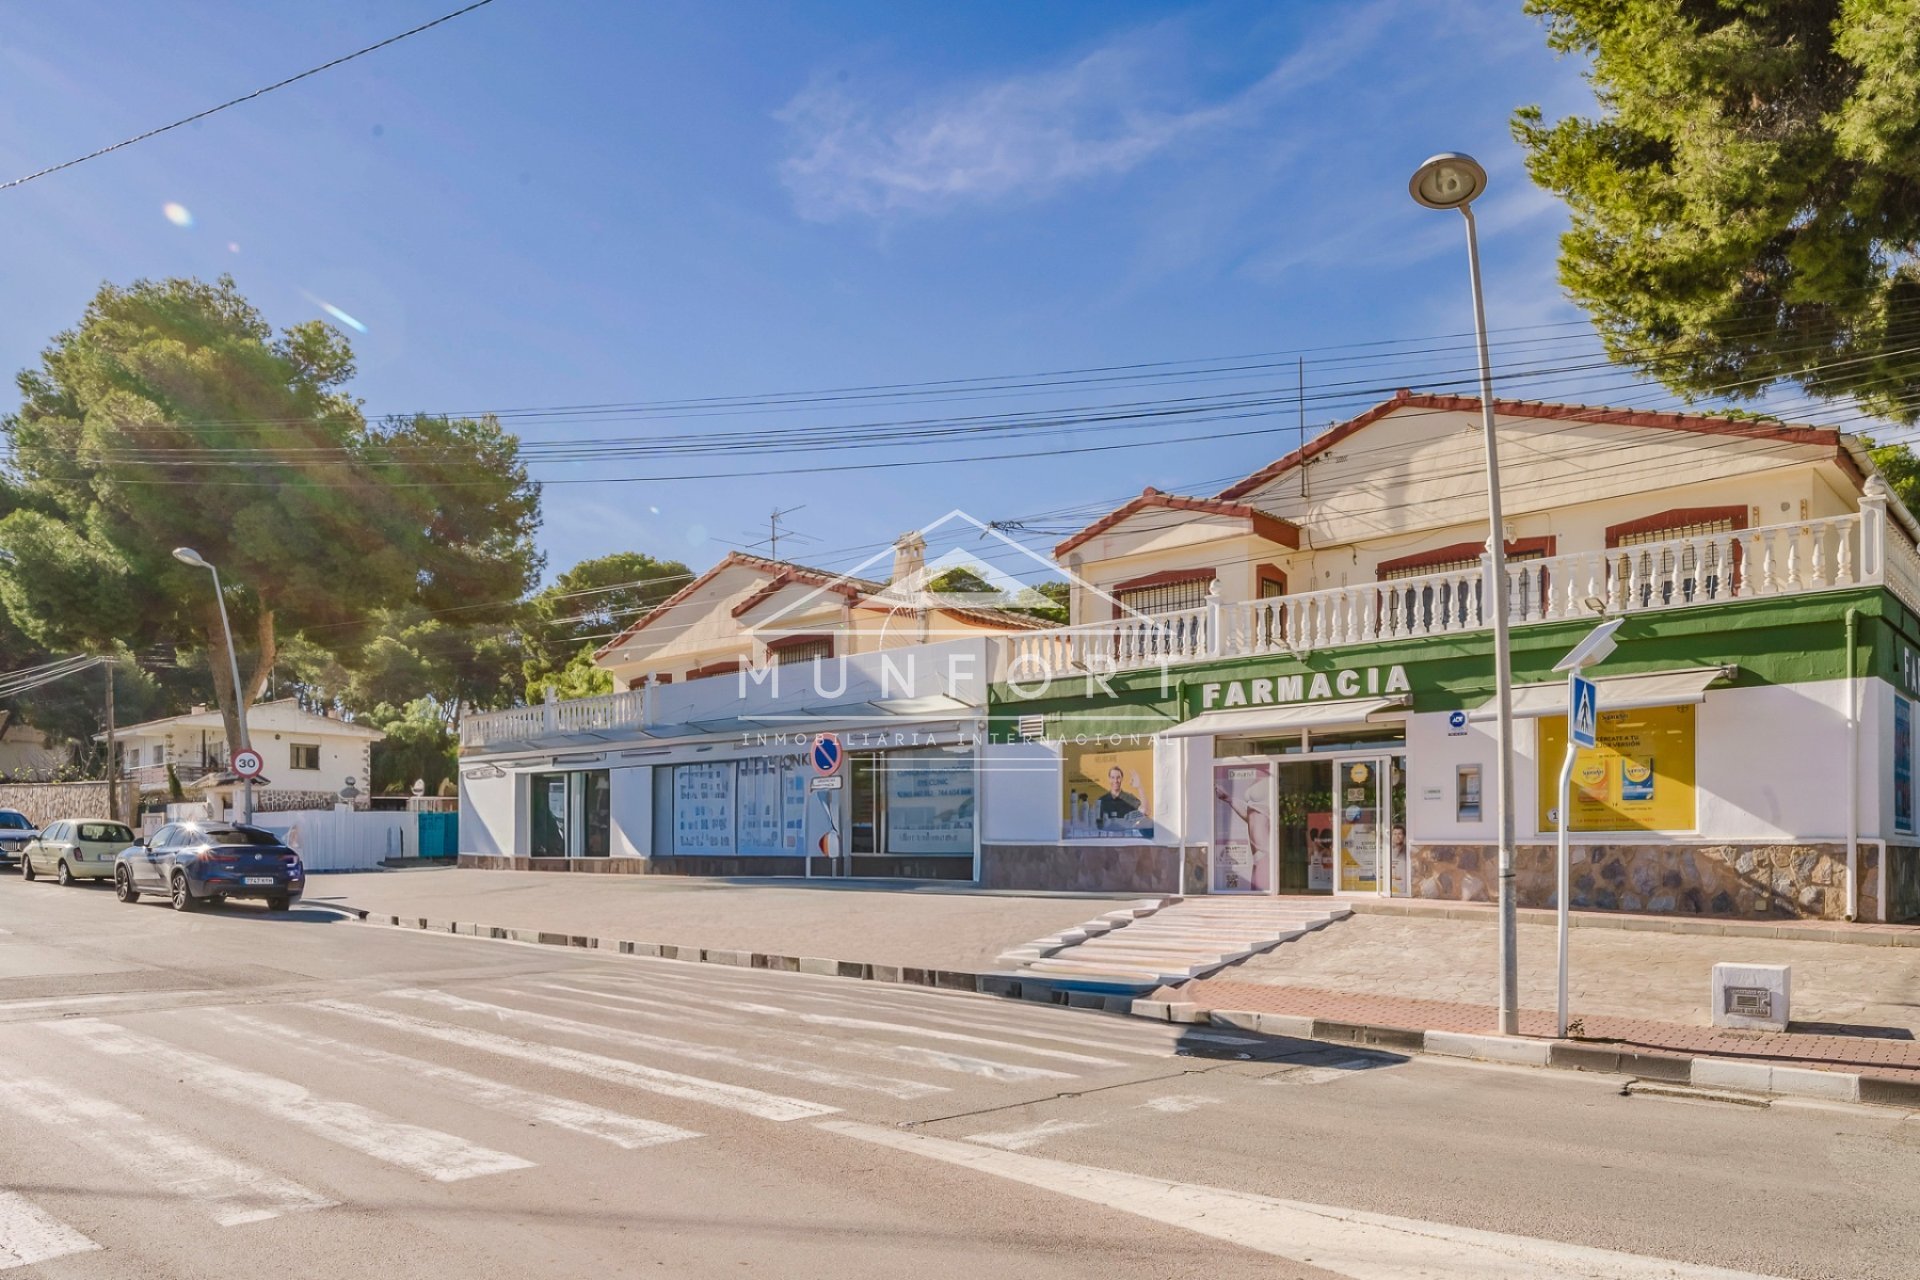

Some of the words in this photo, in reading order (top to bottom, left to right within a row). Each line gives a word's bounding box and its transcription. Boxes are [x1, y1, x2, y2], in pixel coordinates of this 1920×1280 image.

[1202, 665, 1411, 708] FARMACIA
[1904, 646, 1920, 696] FA
[239, 759, 255, 768] 30
